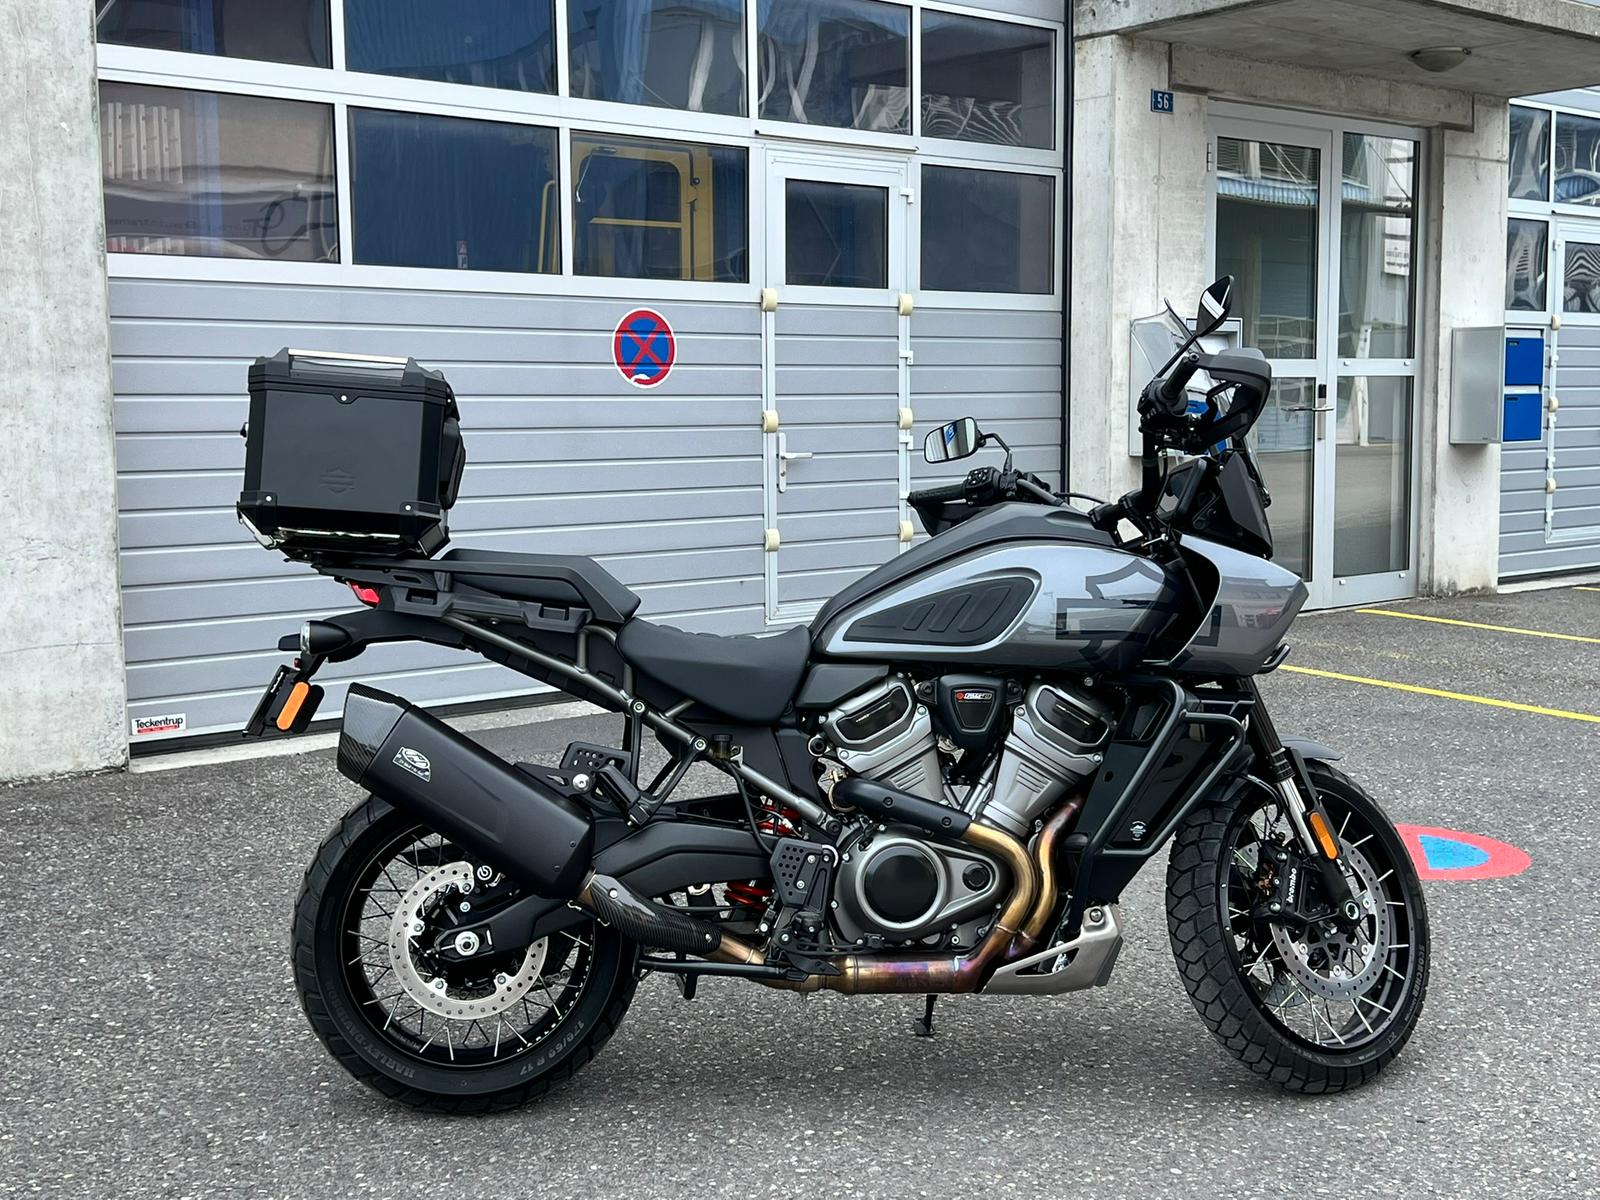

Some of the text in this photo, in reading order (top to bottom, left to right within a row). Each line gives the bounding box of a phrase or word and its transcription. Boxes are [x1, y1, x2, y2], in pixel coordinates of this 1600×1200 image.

[1156, 92, 1169, 109] 56
[135, 716, 184, 728] Teckentrup
[1286, 867, 1297, 903] brembo
